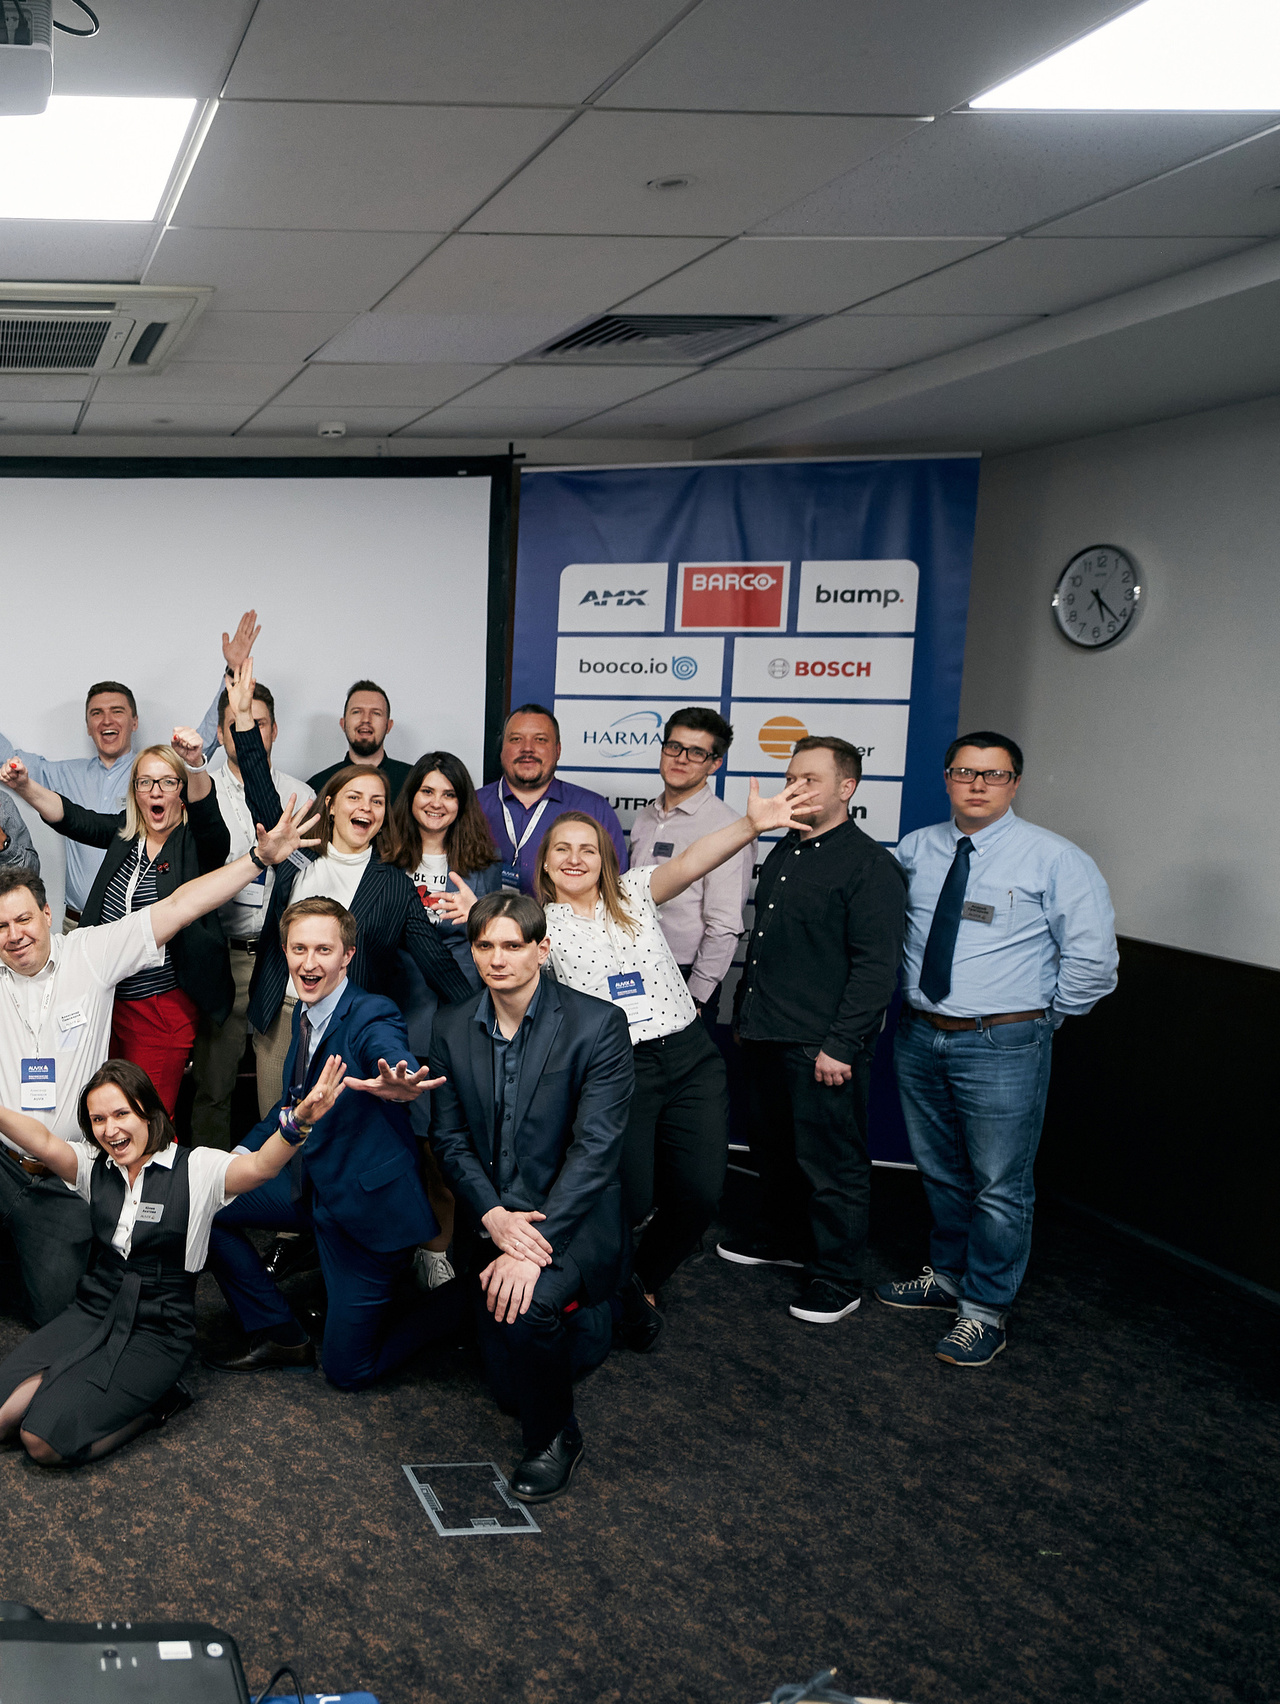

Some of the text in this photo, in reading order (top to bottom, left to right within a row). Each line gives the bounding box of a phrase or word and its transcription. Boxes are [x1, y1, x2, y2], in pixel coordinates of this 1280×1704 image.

[1097, 556, 1106, 567] 12
[692, 573, 777, 591] BARCO
[1069, 576, 1082, 586] 10
[1122, 572, 1130, 583] 2
[578, 589, 650, 606] AMX
[815, 584, 904, 608] biamp.
[1067, 594, 1074, 605] 9
[1069, 611, 1077, 622] 8
[1119, 608, 1127, 618] 4
[1079, 623, 1086, 634] 7
[1108, 621, 1116, 632] 5
[1092, 627, 1100, 638] 6
[579, 658, 668, 674] booco.io
[795, 661, 871, 677] BOSCH
[583, 731, 664, 745] HARMA
